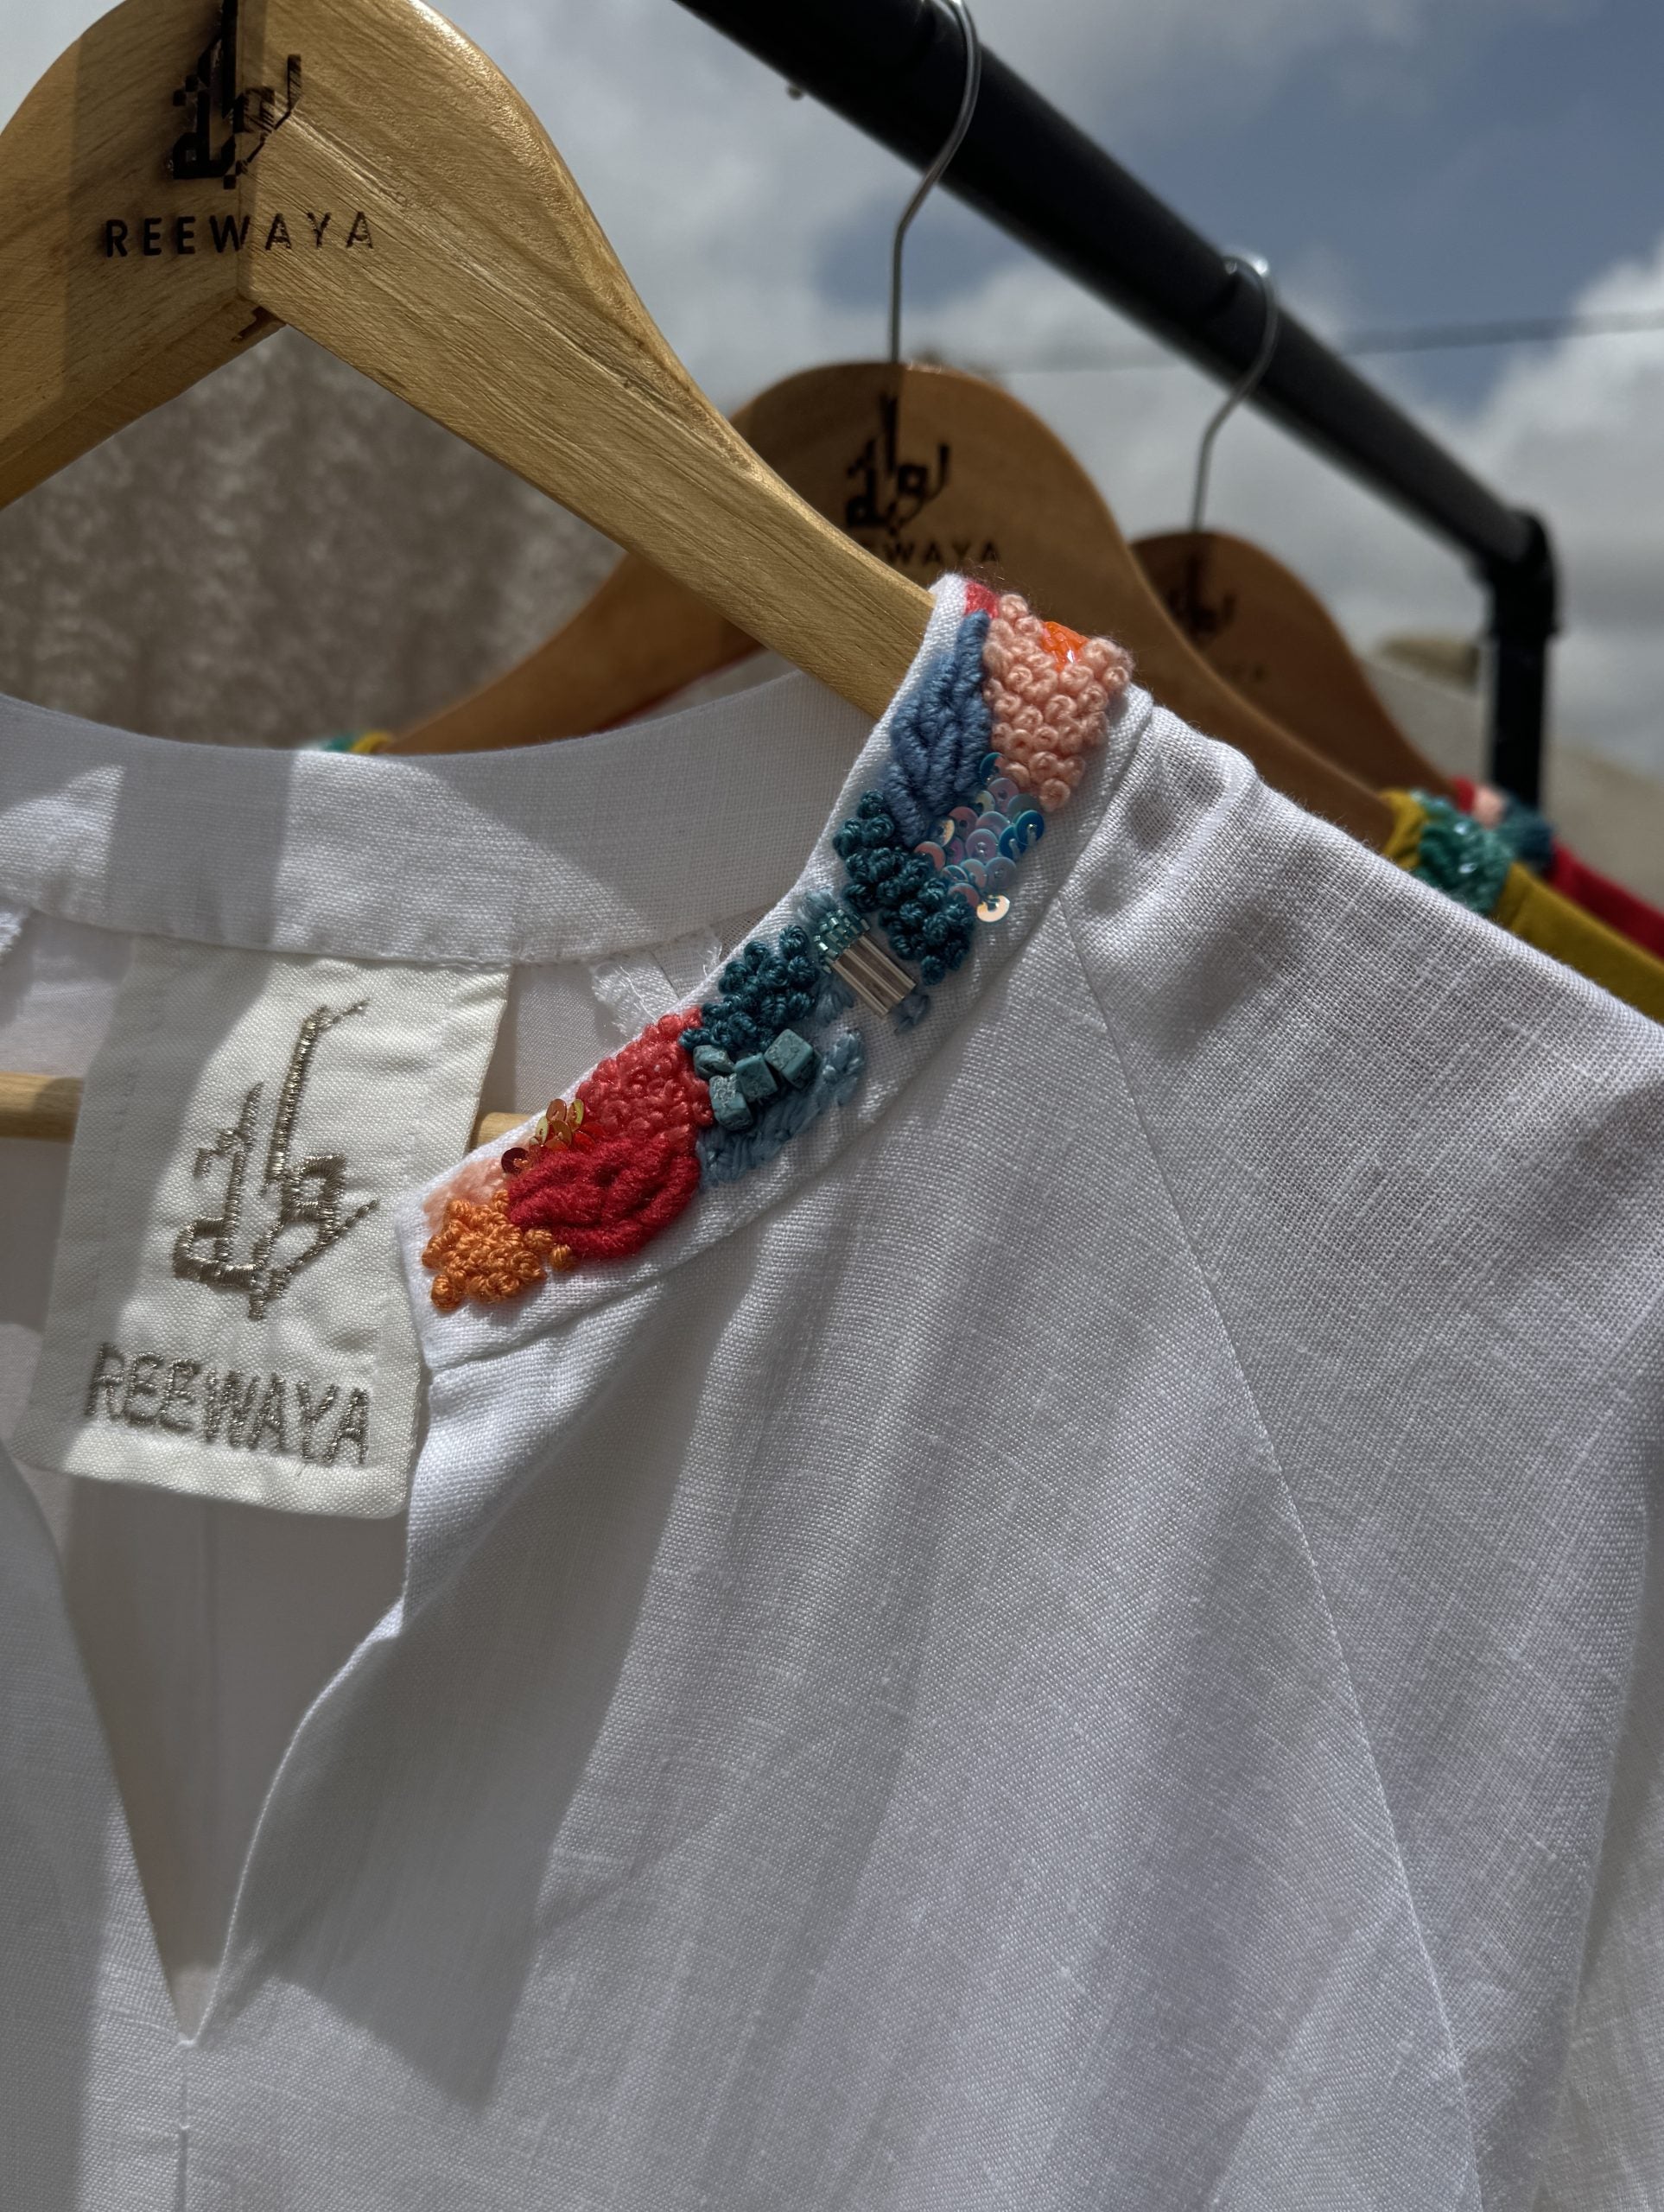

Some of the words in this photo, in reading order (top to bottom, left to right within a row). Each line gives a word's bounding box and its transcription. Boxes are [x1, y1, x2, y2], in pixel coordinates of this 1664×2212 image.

[105, 212, 373, 257] REEWAYA
[863, 539, 1000, 564] WAYA
[85, 1343, 368, 1466] REEWAYA
